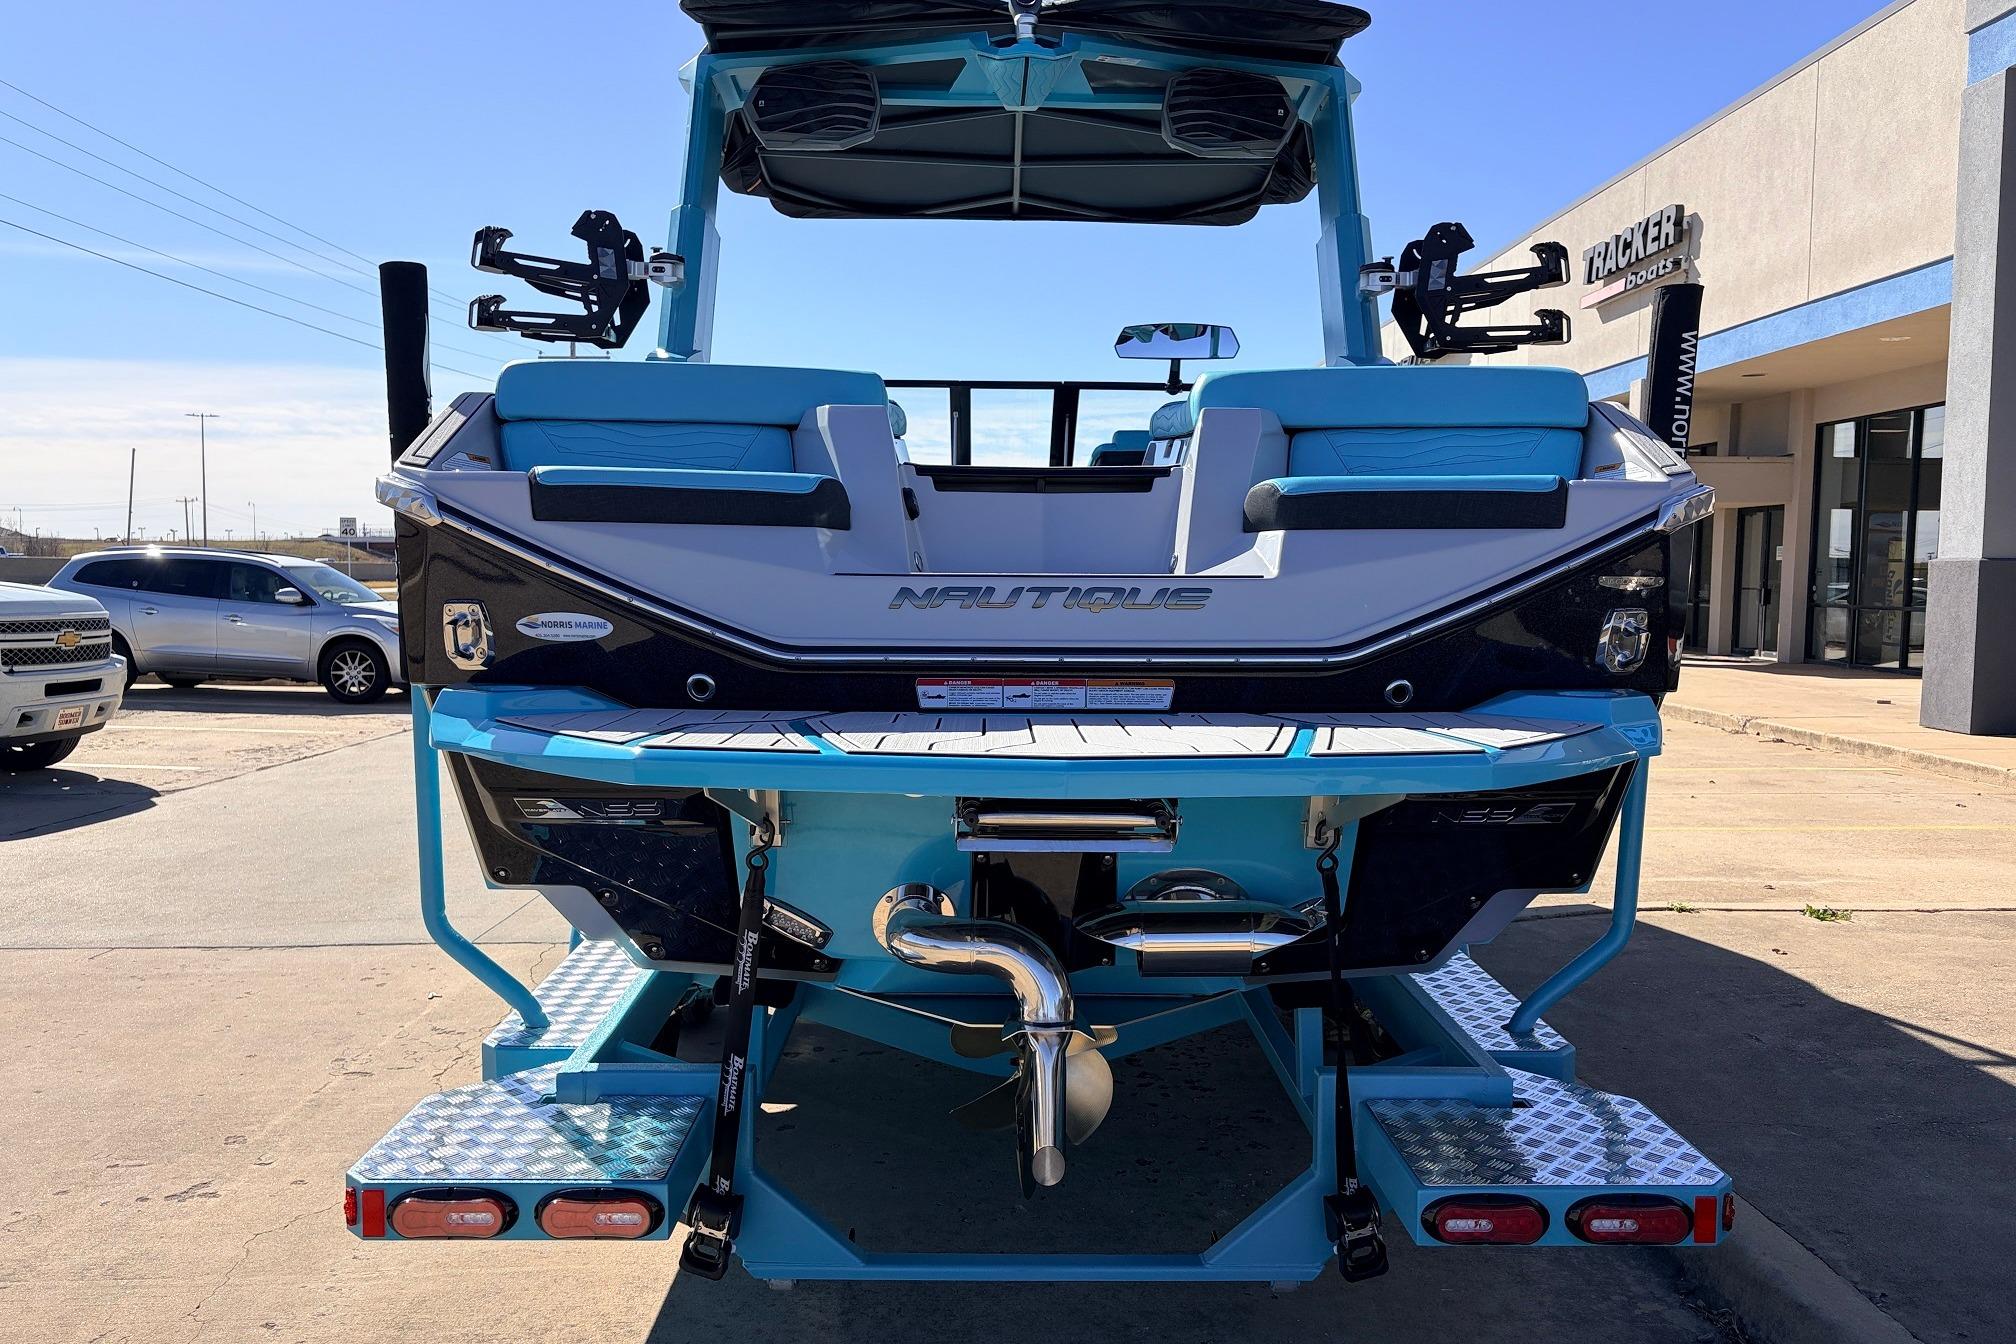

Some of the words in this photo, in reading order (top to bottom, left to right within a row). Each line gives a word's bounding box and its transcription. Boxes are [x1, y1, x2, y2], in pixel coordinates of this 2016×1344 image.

[1582, 204, 1685, 285] TRACKER
[1625, 256, 1674, 290] boats
[341, 528, 355, 536] 40
[888, 586, 1213, 613] NAUTIQUE
[541, 620, 573, 629] NORRIS
[575, 621, 608, 630] MARINE
